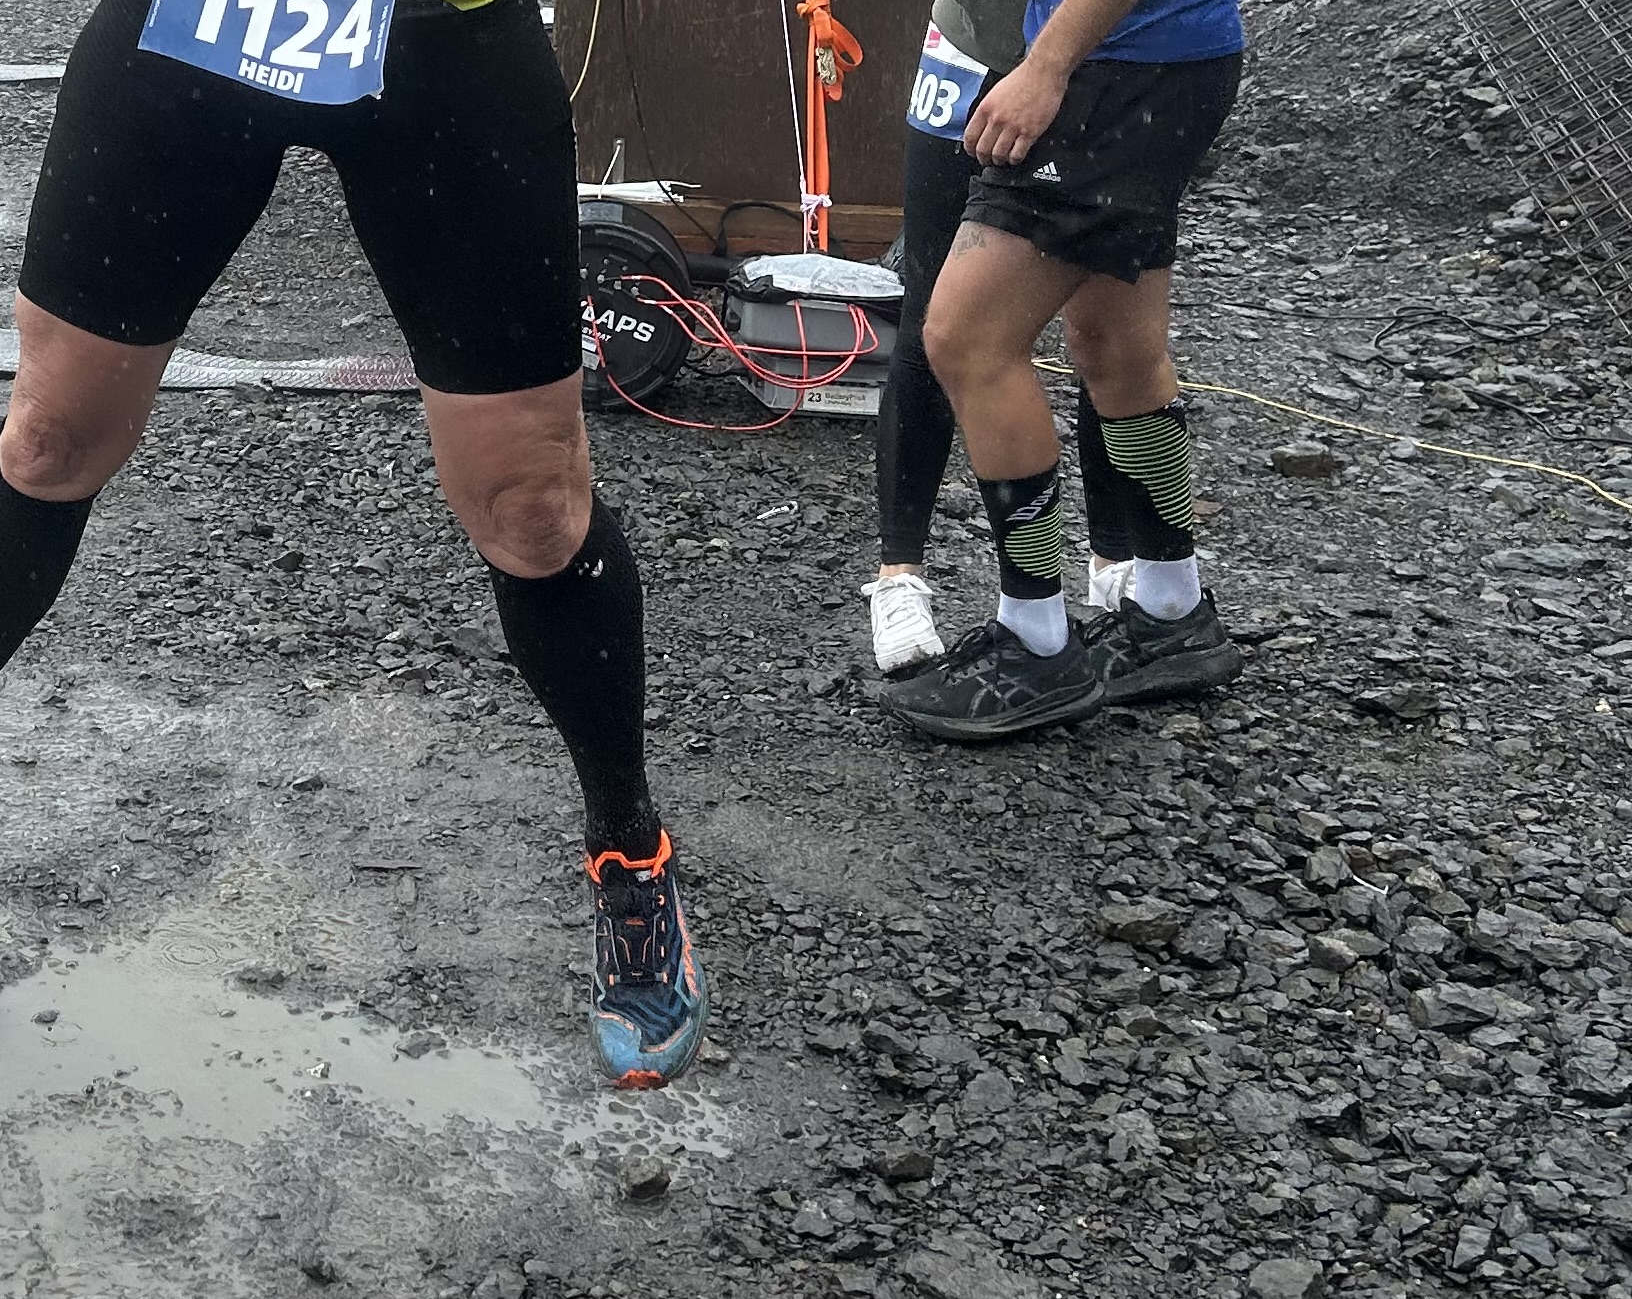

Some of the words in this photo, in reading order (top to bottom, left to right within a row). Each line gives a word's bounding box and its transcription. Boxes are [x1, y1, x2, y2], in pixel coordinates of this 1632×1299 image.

[238, 58, 305, 94] HEIDI
[1032, 171, 1062, 182] adidas
[580, 301, 655, 342] LAPS
[808, 392, 822, 403] 23
